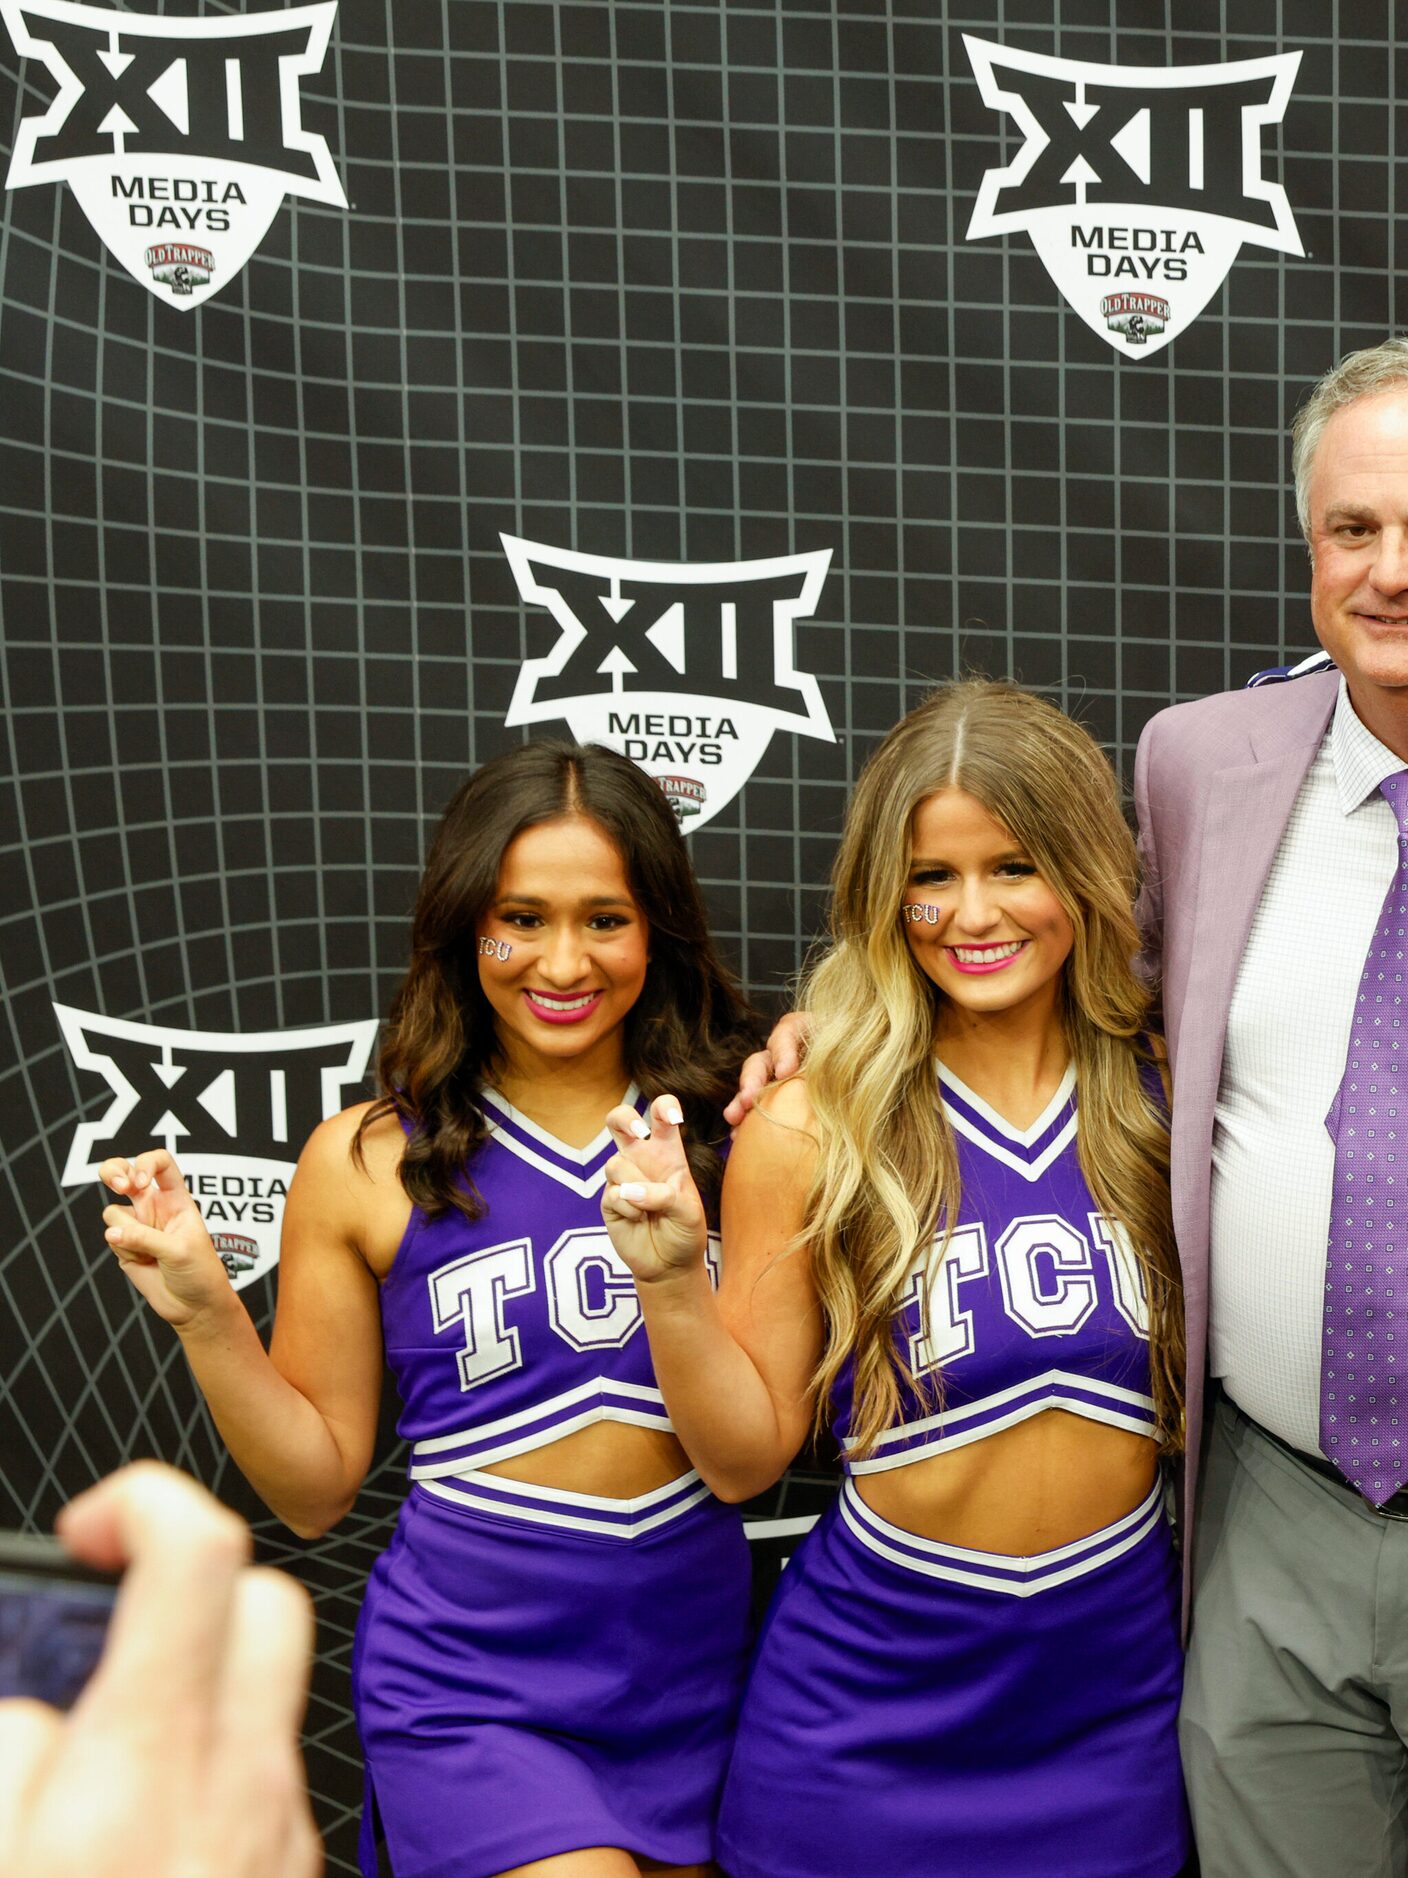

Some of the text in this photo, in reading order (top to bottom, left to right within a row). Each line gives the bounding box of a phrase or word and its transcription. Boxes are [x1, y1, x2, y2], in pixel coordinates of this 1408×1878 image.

[20, 9, 321, 182] XII
[989, 61, 1280, 231] XII
[111, 175, 247, 205] MEDIA
[129, 204, 230, 231] DAYS
[1071, 225, 1205, 254] MEDIA
[1087, 253, 1188, 281] DAYS
[527, 558, 811, 719] XII
[609, 712, 739, 740] MEDIA
[625, 739, 722, 765] DAYS
[903, 904, 940, 925] TCU
[479, 936, 512, 962] TCU
[80, 1027, 355, 1165] XII
[427, 1226, 722, 1392] TC
